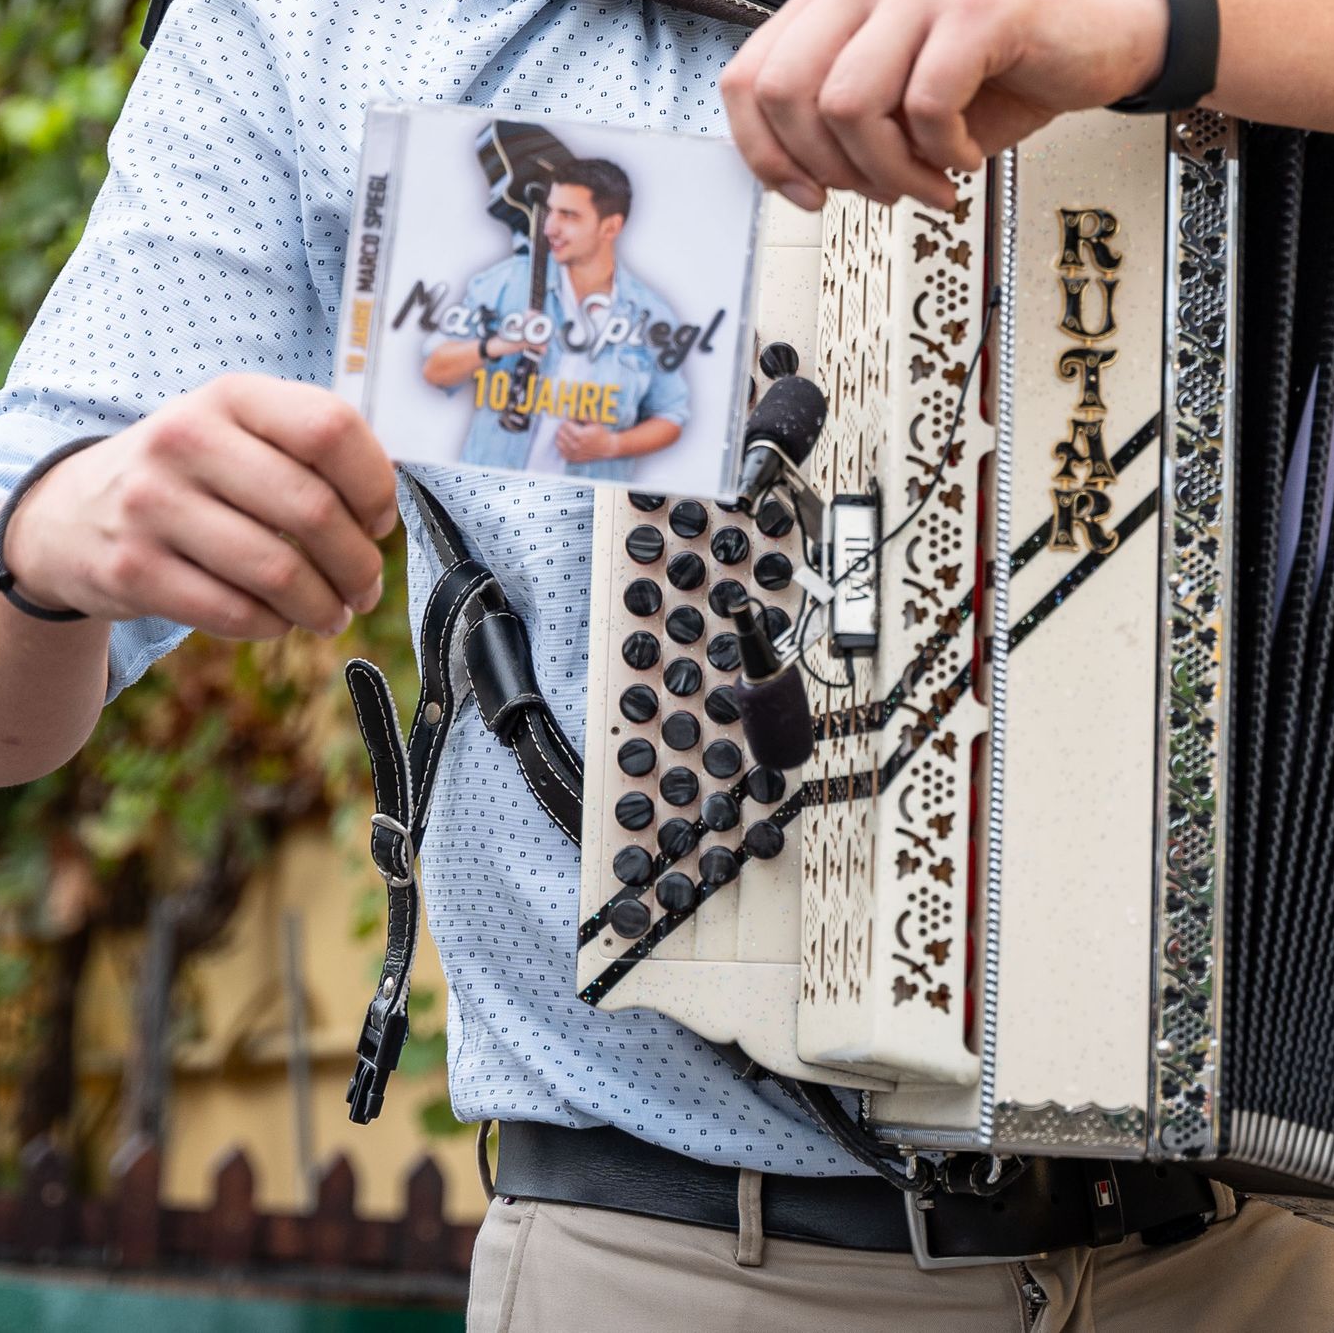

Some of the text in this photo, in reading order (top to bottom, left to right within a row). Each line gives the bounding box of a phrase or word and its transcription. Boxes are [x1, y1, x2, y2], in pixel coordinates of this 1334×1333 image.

[362, 172, 389, 230] SPIEGL
[355, 233, 381, 293] MARCO
[391, 279, 727, 372] Marco Spiegl
[472, 367, 621, 426] 10 JAHRE
[1049, 208, 1123, 553] RUTAR
